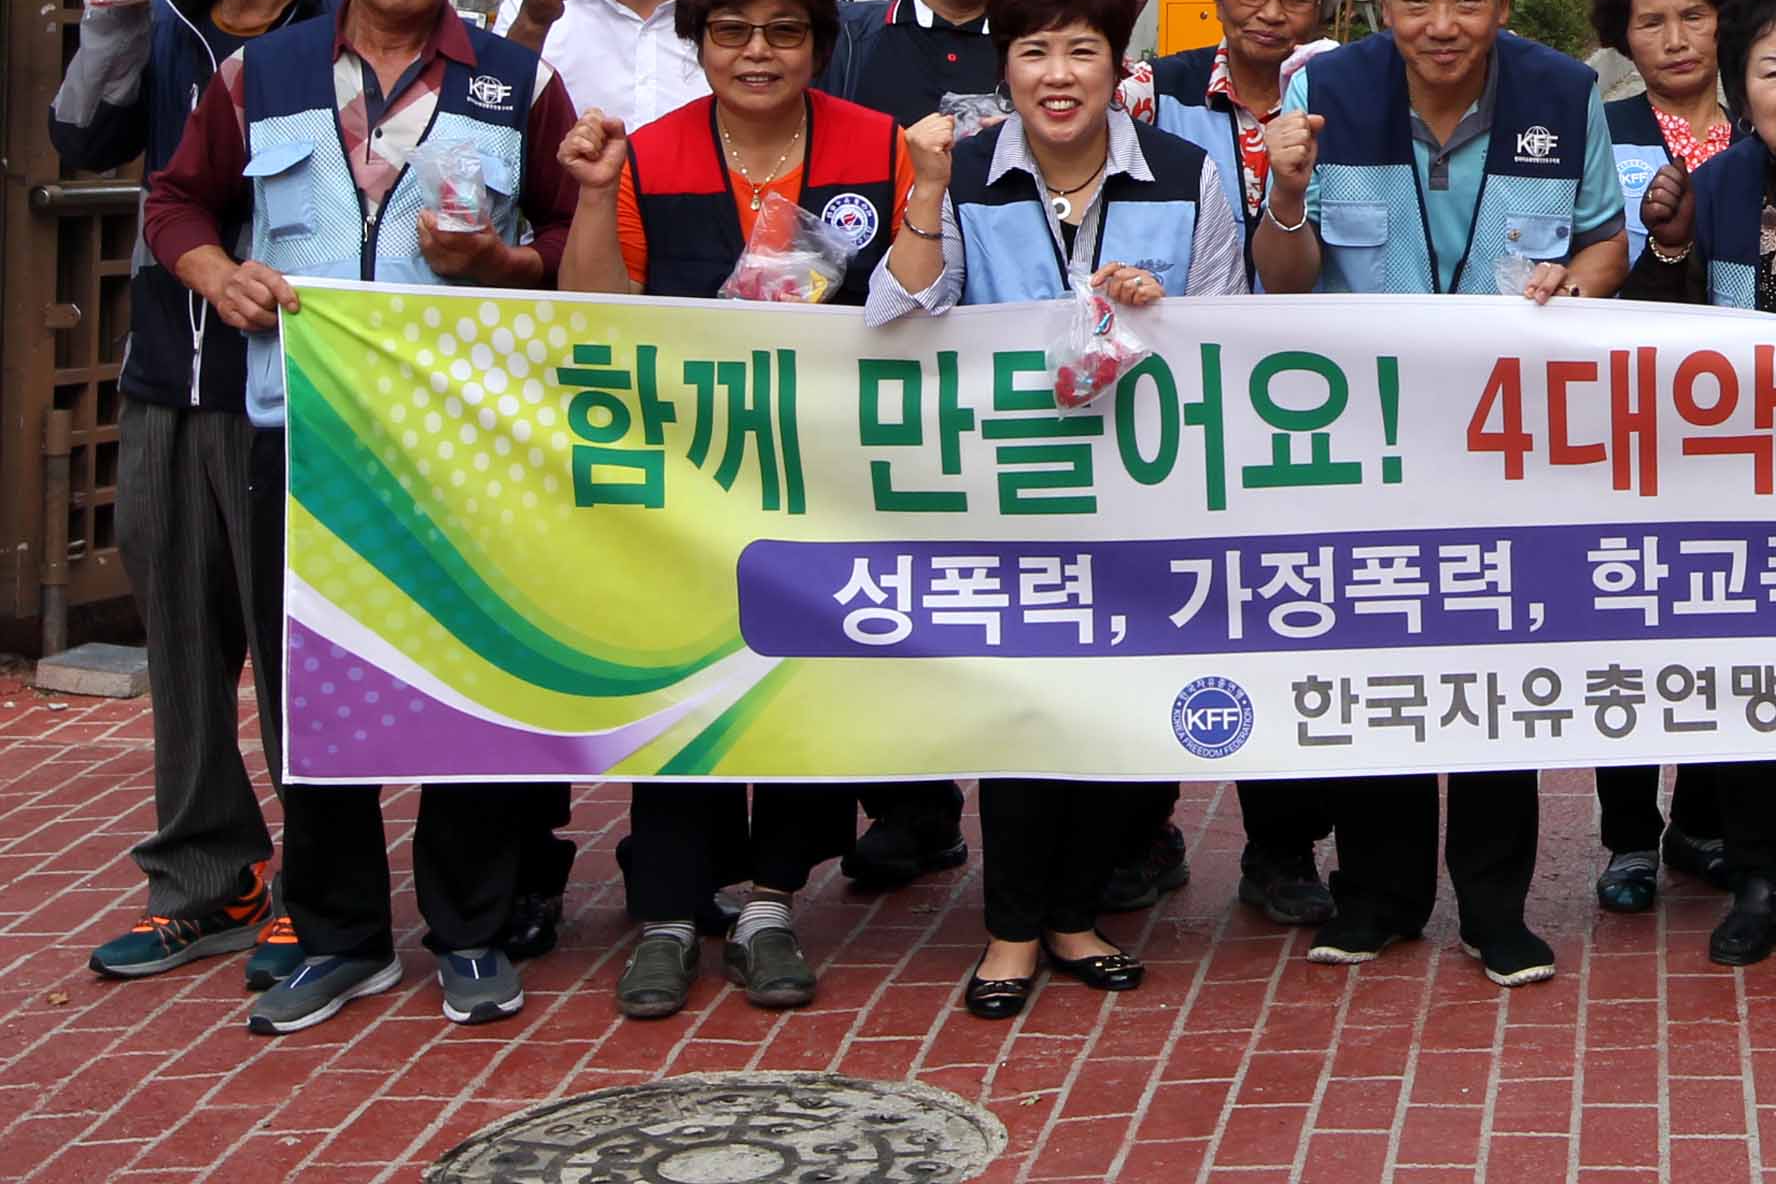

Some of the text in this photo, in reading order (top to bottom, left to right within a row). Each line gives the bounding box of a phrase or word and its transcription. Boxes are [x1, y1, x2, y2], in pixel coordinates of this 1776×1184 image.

[469, 77, 513, 103] KFF
[1517, 133, 1559, 154] KFF
[556, 343, 806, 516] 함께
[857, 342, 1403, 516] 만들어요!
[833, 553, 1129, 647] 성폭력,
[1167, 537, 1546, 639] 가정폭력,
[1186, 708, 1240, 730] KFF
